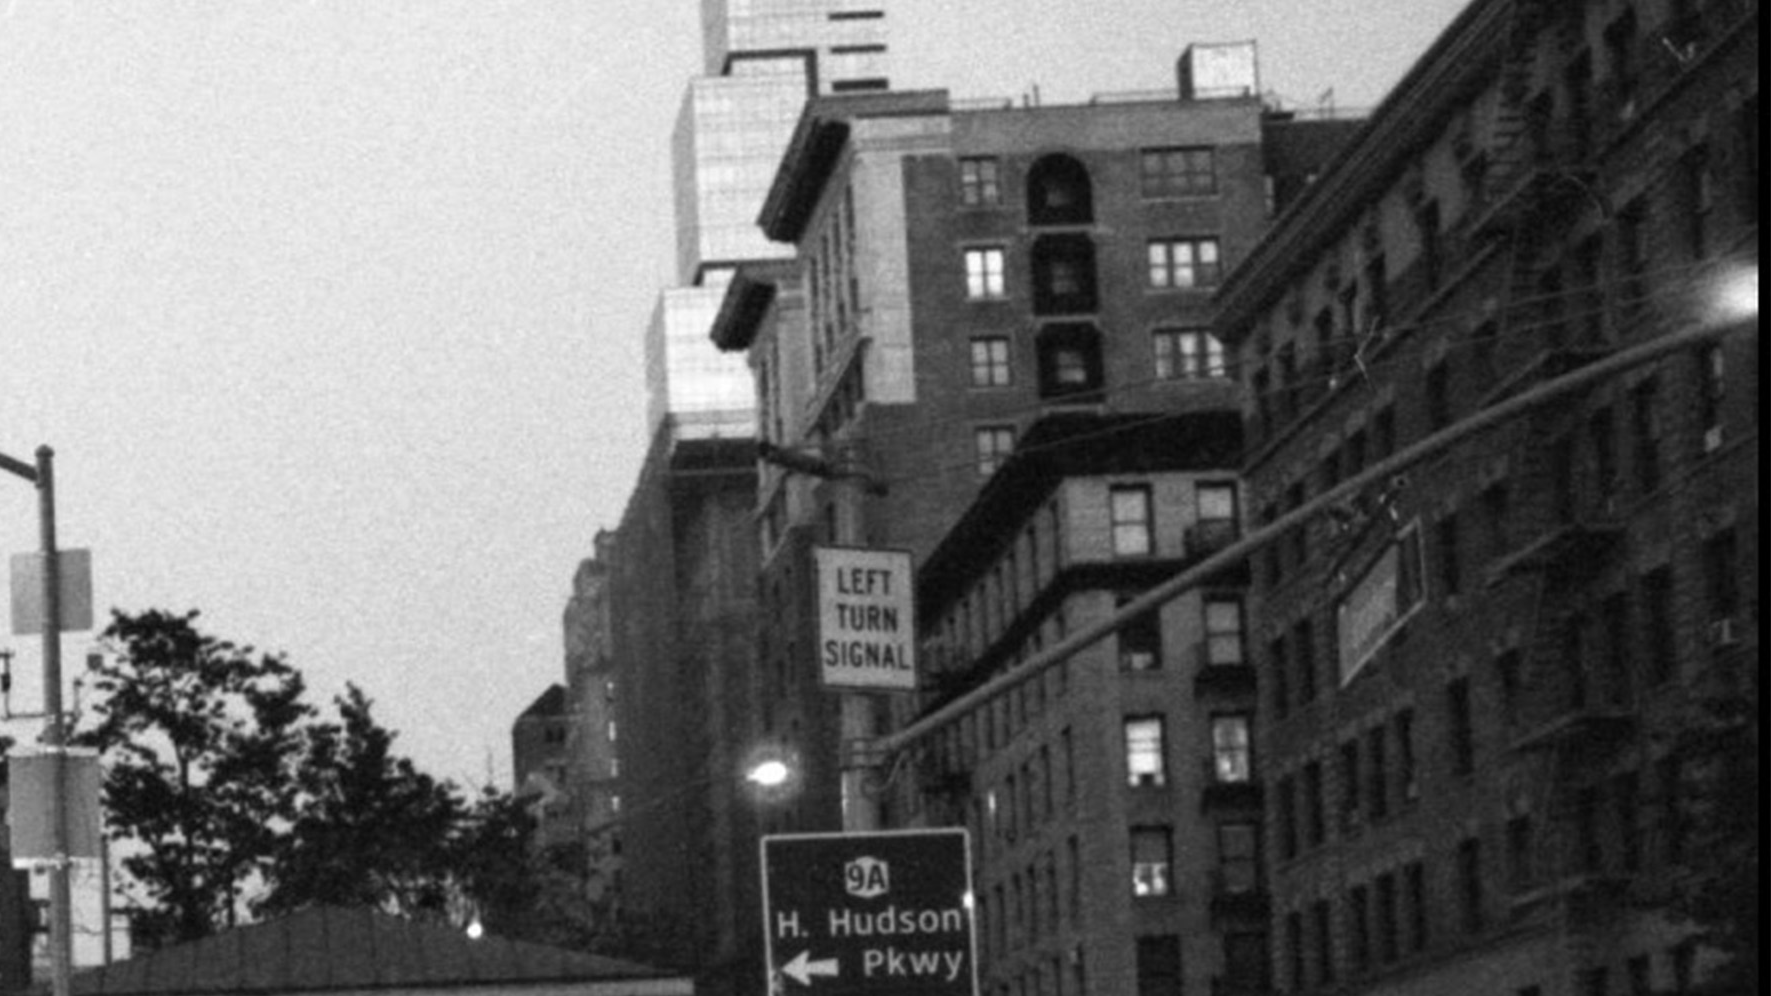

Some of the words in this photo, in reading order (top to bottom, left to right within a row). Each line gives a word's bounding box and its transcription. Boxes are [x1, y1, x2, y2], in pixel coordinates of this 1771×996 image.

[837, 567, 891, 595] LEFT
[836, 603, 898, 632] TURN
[825, 640, 910, 670] SIGNAL
[847, 864, 886, 891] 9A
[777, 910, 809, 938] H.
[829, 905, 962, 937] Hudson
[863, 946, 963, 981] Pkwy
